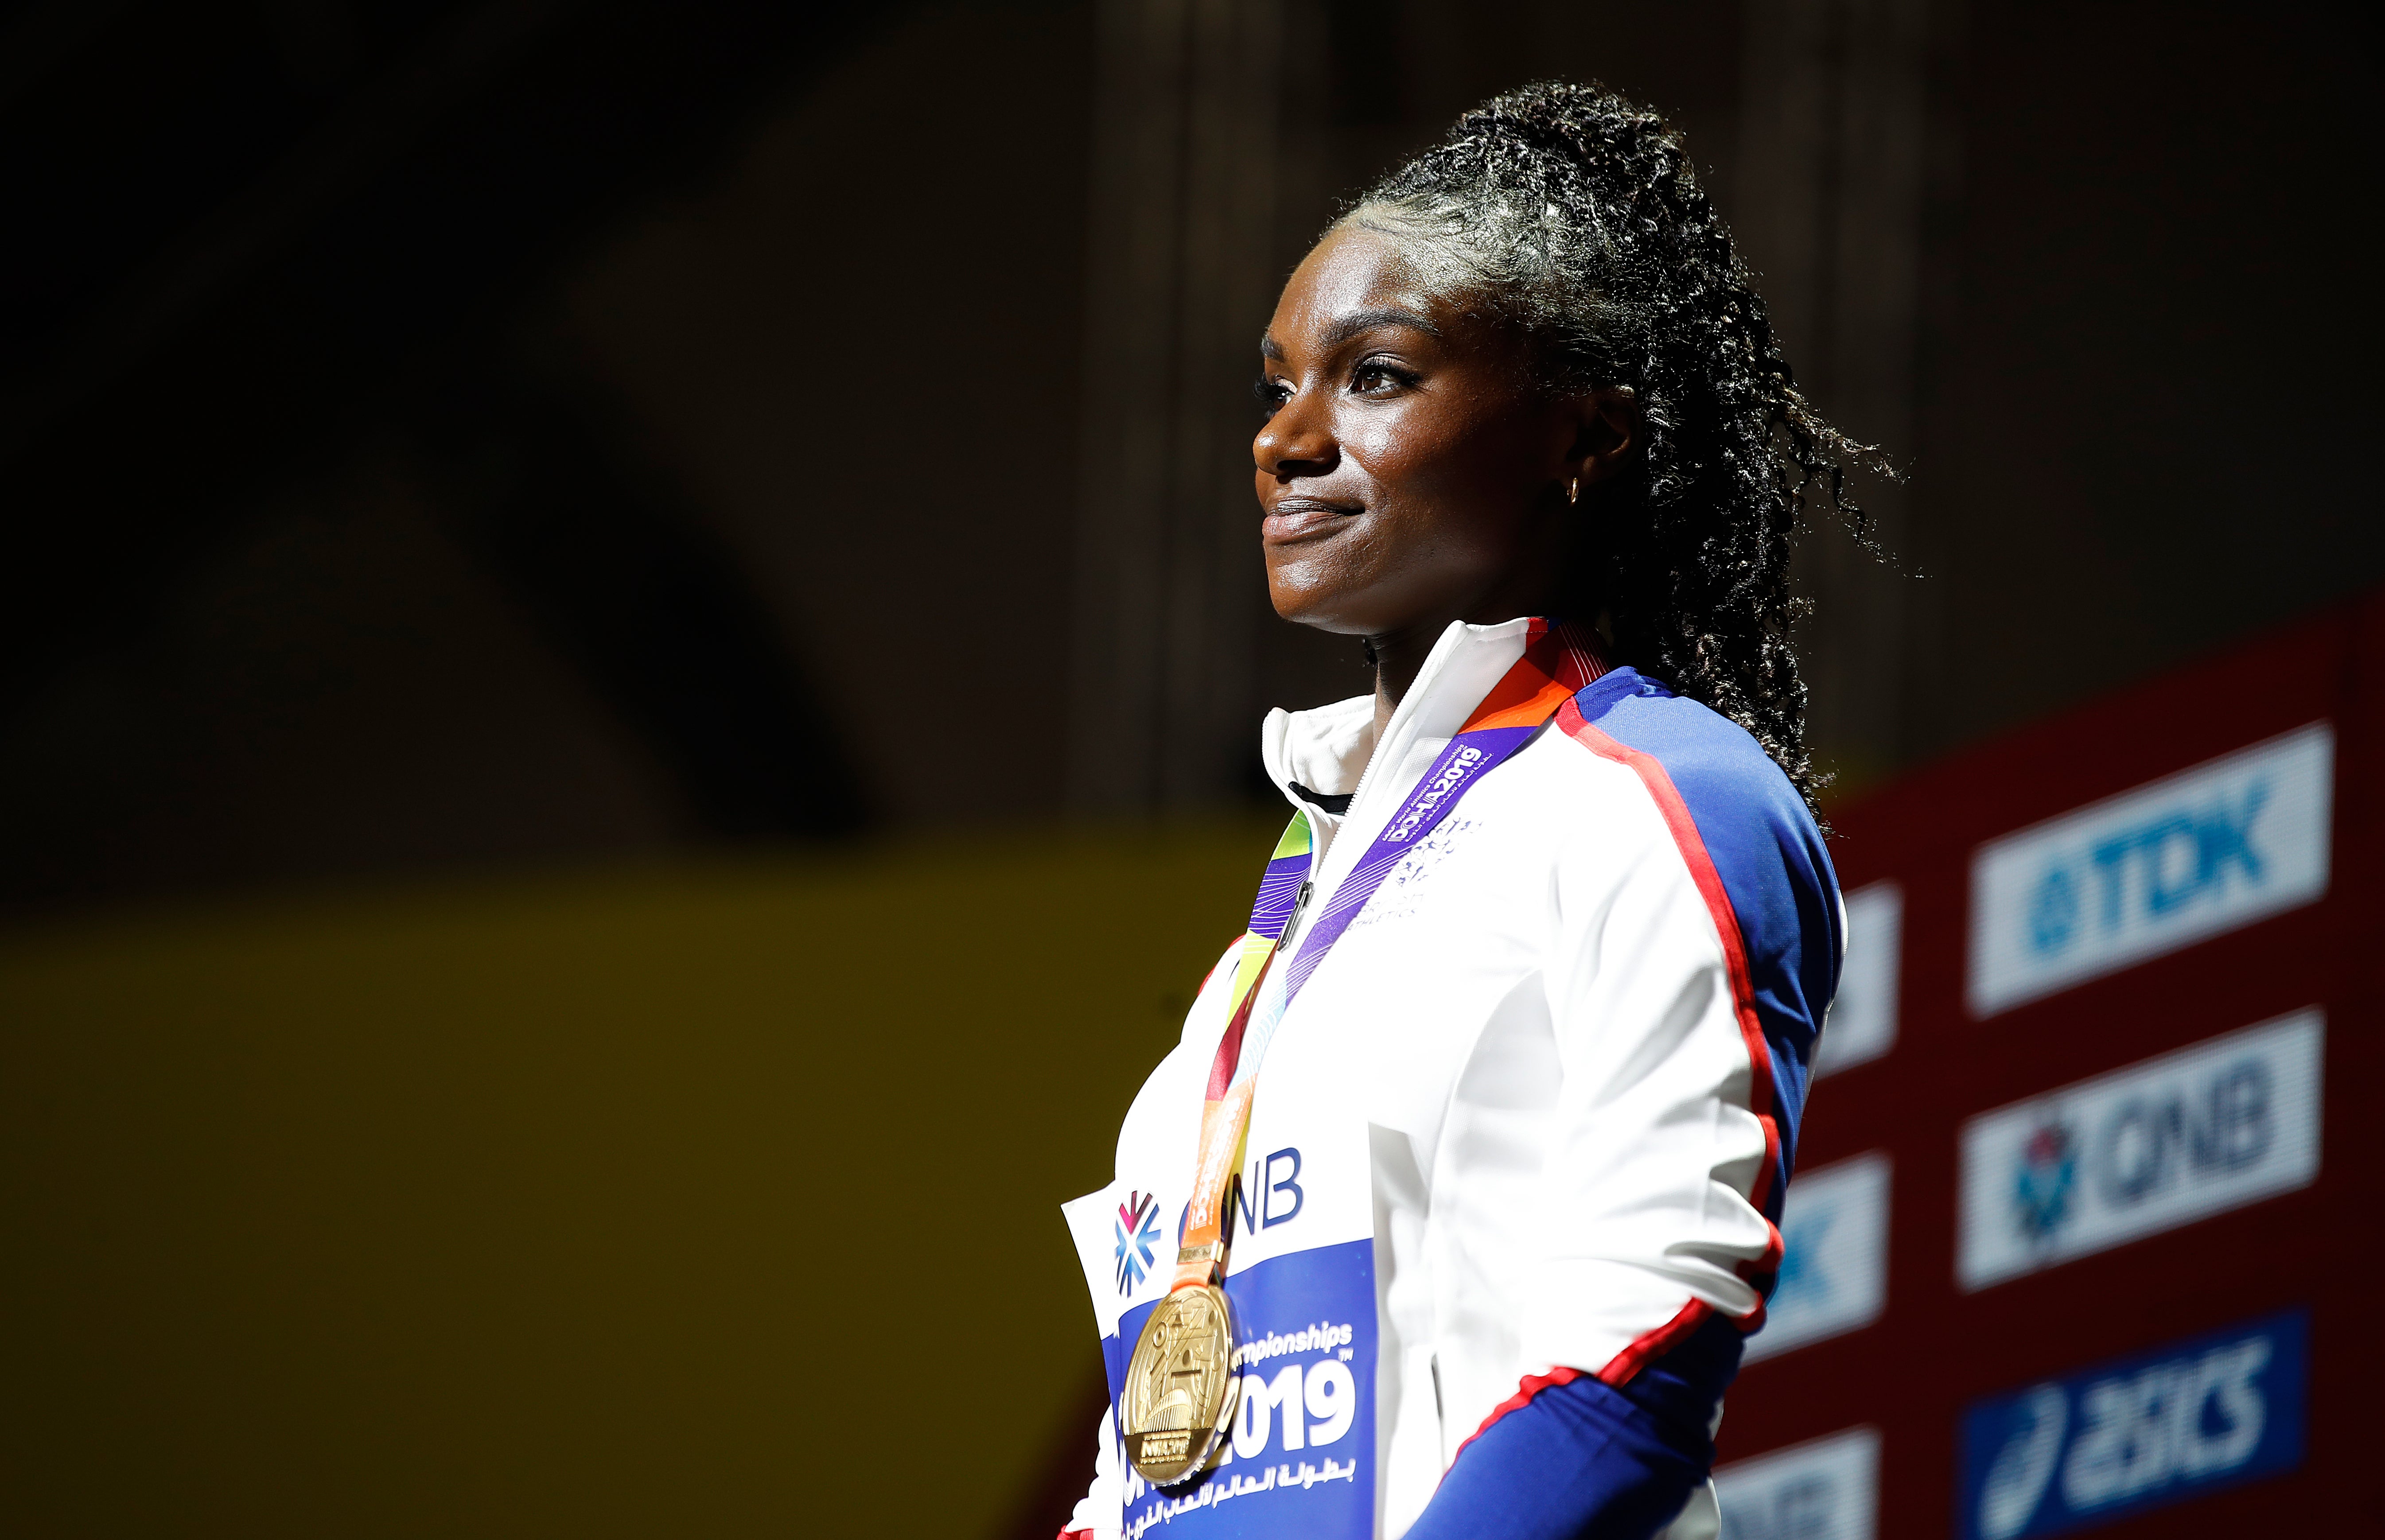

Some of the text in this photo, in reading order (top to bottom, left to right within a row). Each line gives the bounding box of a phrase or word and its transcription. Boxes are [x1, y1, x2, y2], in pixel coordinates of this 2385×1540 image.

[1396, 807, 1411, 824] World
[1411, 784, 1431, 808] Athletics
[1429, 743, 1464, 784] Championships
[2092, 775, 2269, 933] TDK
[1347, 908, 1418, 931] ATHLETICS
[2093, 1054, 2274, 1215] QNB
